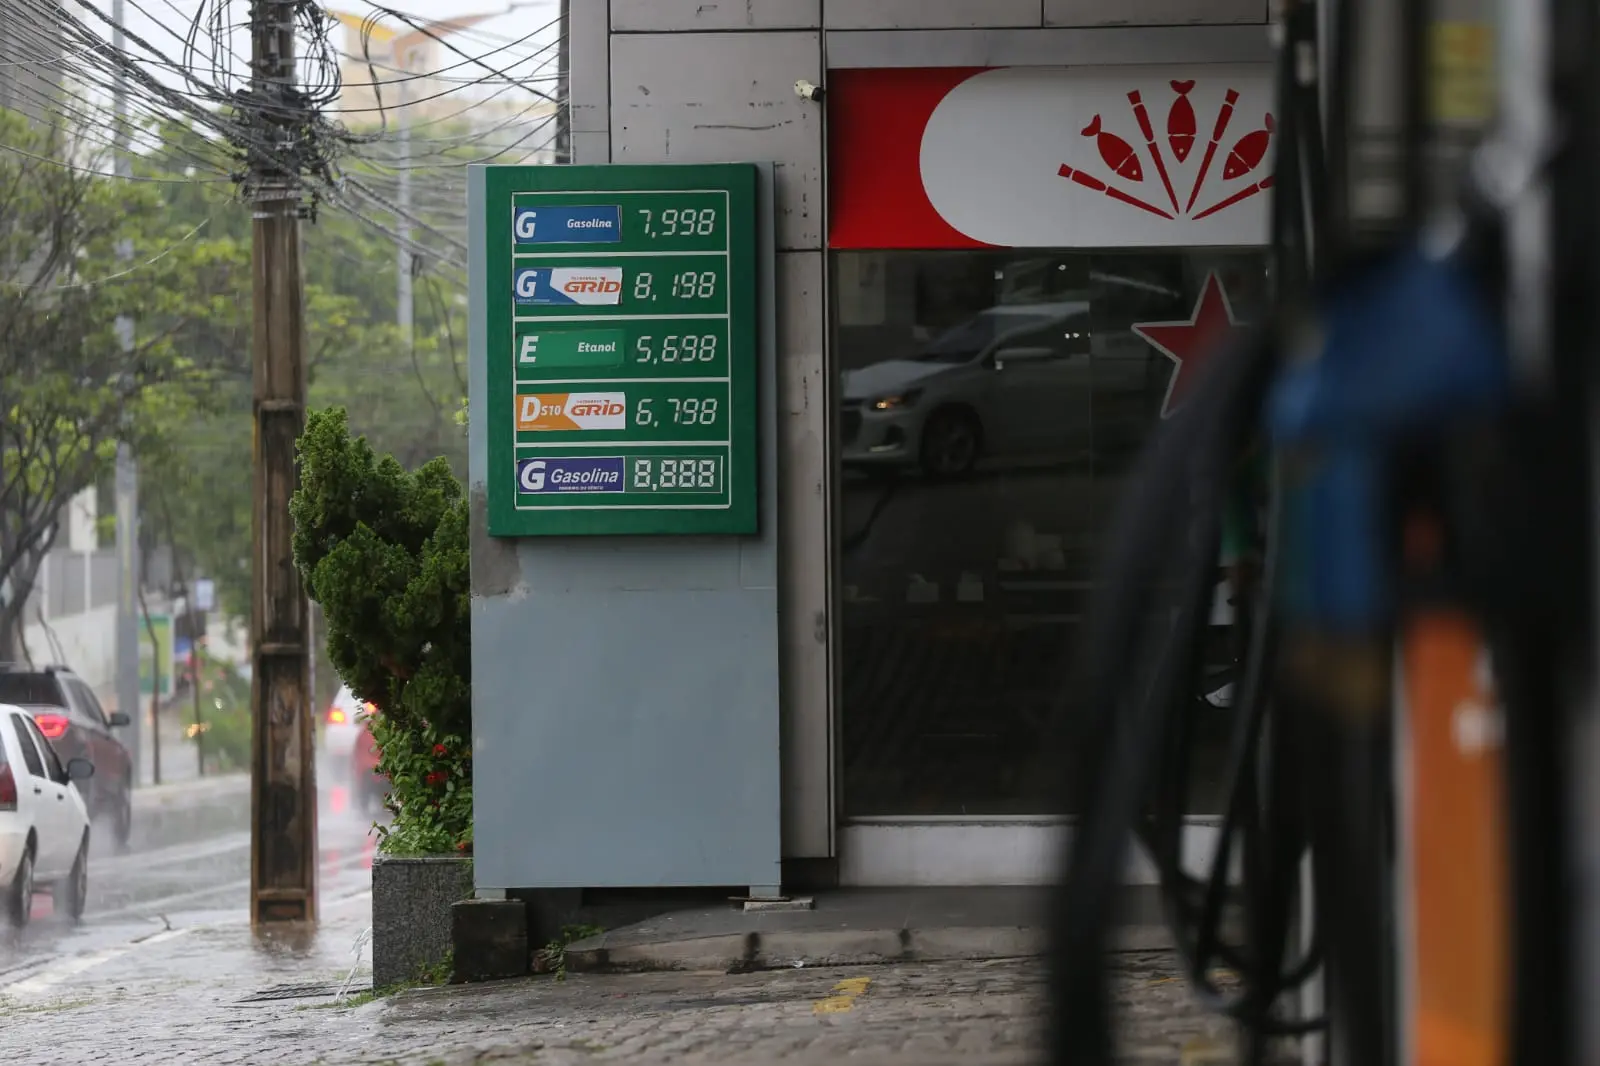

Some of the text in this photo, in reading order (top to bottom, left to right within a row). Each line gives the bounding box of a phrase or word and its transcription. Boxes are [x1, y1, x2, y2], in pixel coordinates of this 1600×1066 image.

[516, 208, 716, 239] G Gasolina 7,998
[516, 270, 716, 301] G GRID 8,198
[519, 334, 718, 365] E Etanol 5,698
[571, 400, 625, 416] GRID
[635, 398, 718, 428] 6,798
[520, 459, 715, 491] G Gasolina 8,888
